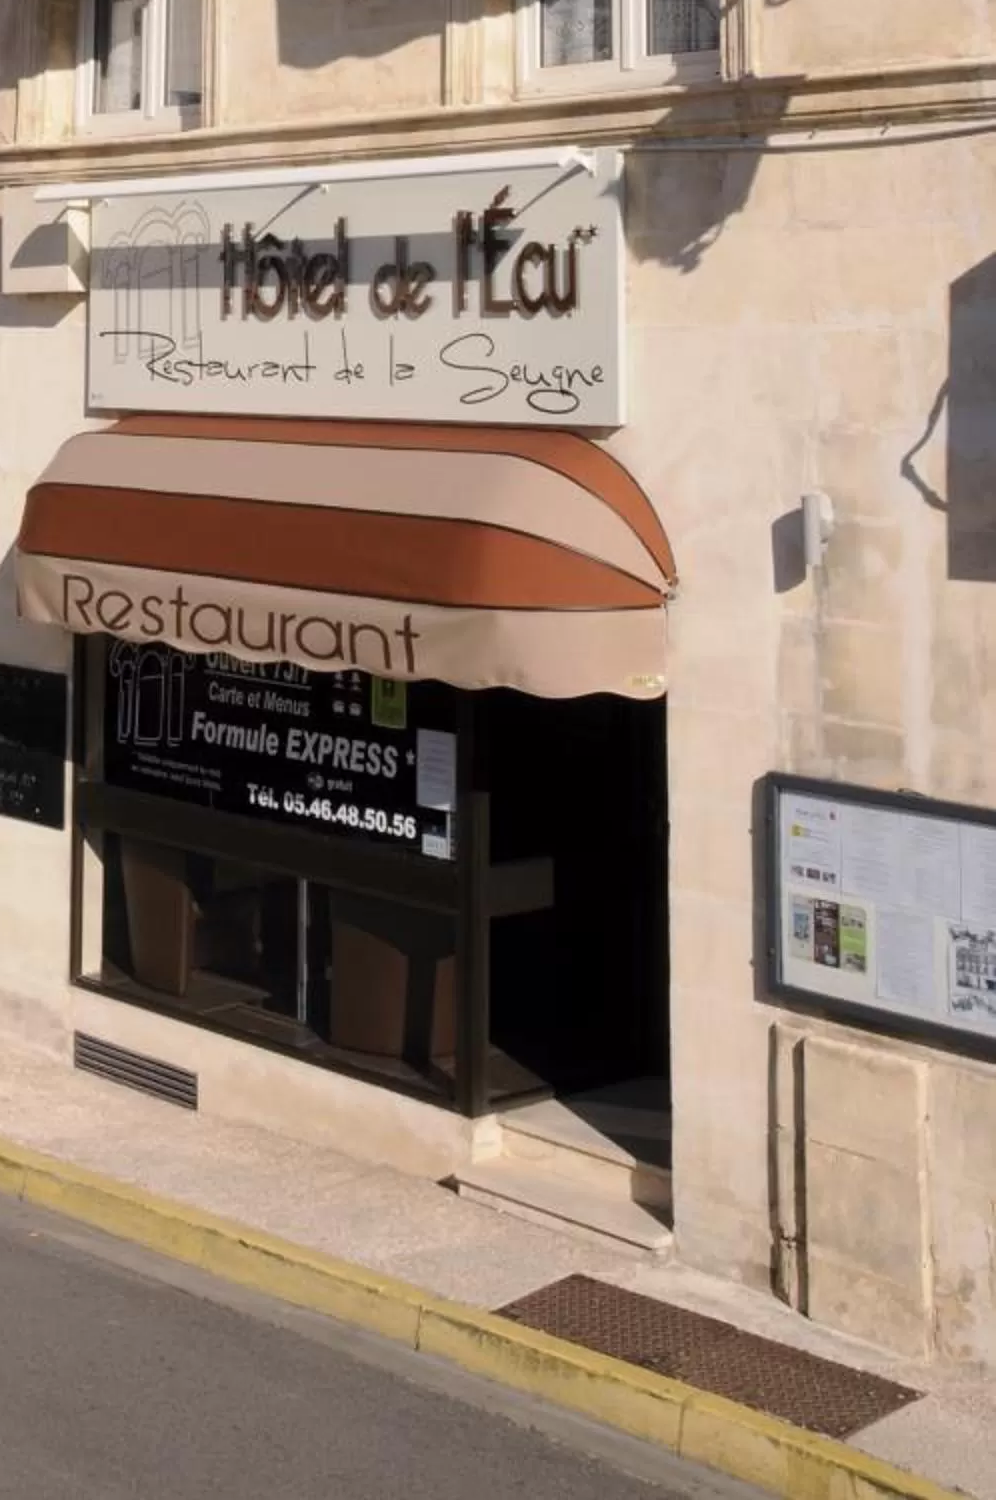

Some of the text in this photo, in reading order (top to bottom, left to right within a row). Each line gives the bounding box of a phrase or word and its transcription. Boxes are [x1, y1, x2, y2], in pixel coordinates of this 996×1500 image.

[220, 217, 348, 321] Hôtel
[370, 235, 436, 321] de
[99, 328, 604, 414] Restaurant de la Seugne
[62, 574, 420, 673] Restaurant
[209, 680, 310, 717] Carte et Menus
[191, 710, 279, 757] Formule
[285, 727, 399, 779] EXPRESS
[247, 782, 279, 809] Tél.
[283, 791, 416, 839] 05.46.48.50.56
